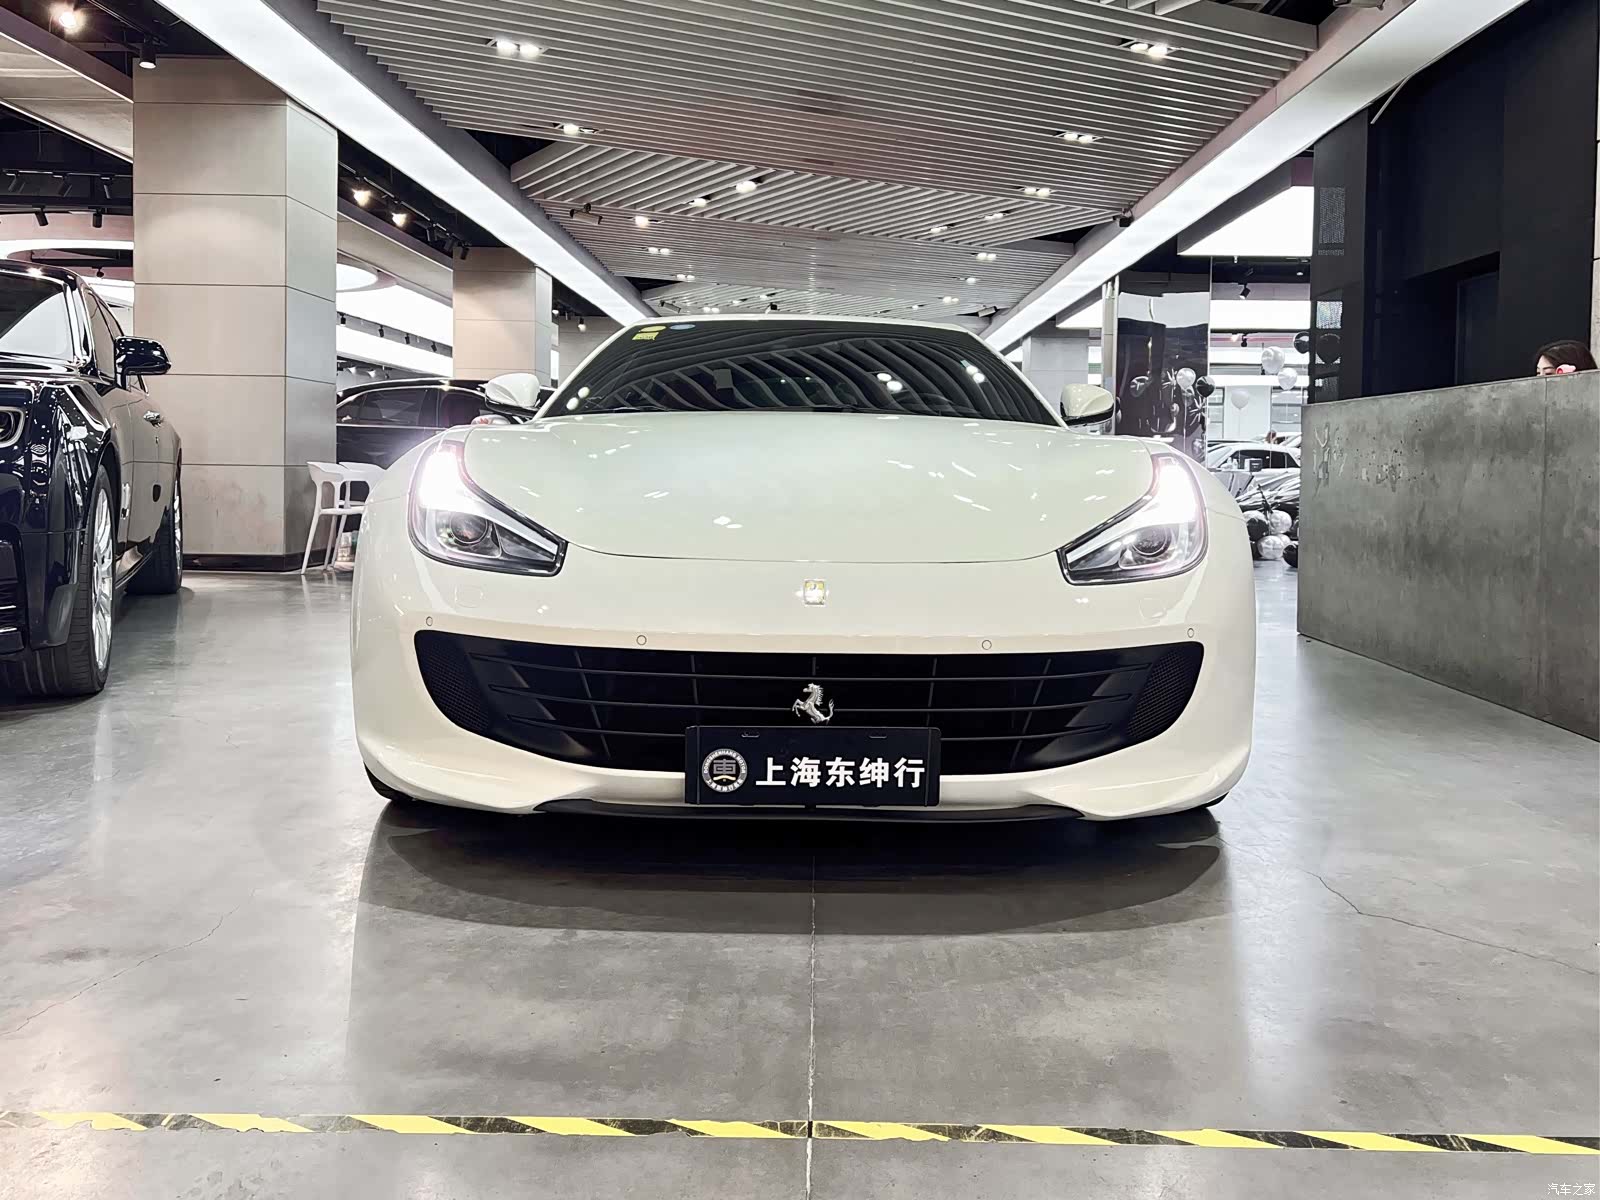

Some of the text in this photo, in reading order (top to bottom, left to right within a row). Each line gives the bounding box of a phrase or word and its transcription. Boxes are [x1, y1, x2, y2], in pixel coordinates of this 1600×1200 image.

[756, 757, 925, 788] 上海东绅行
